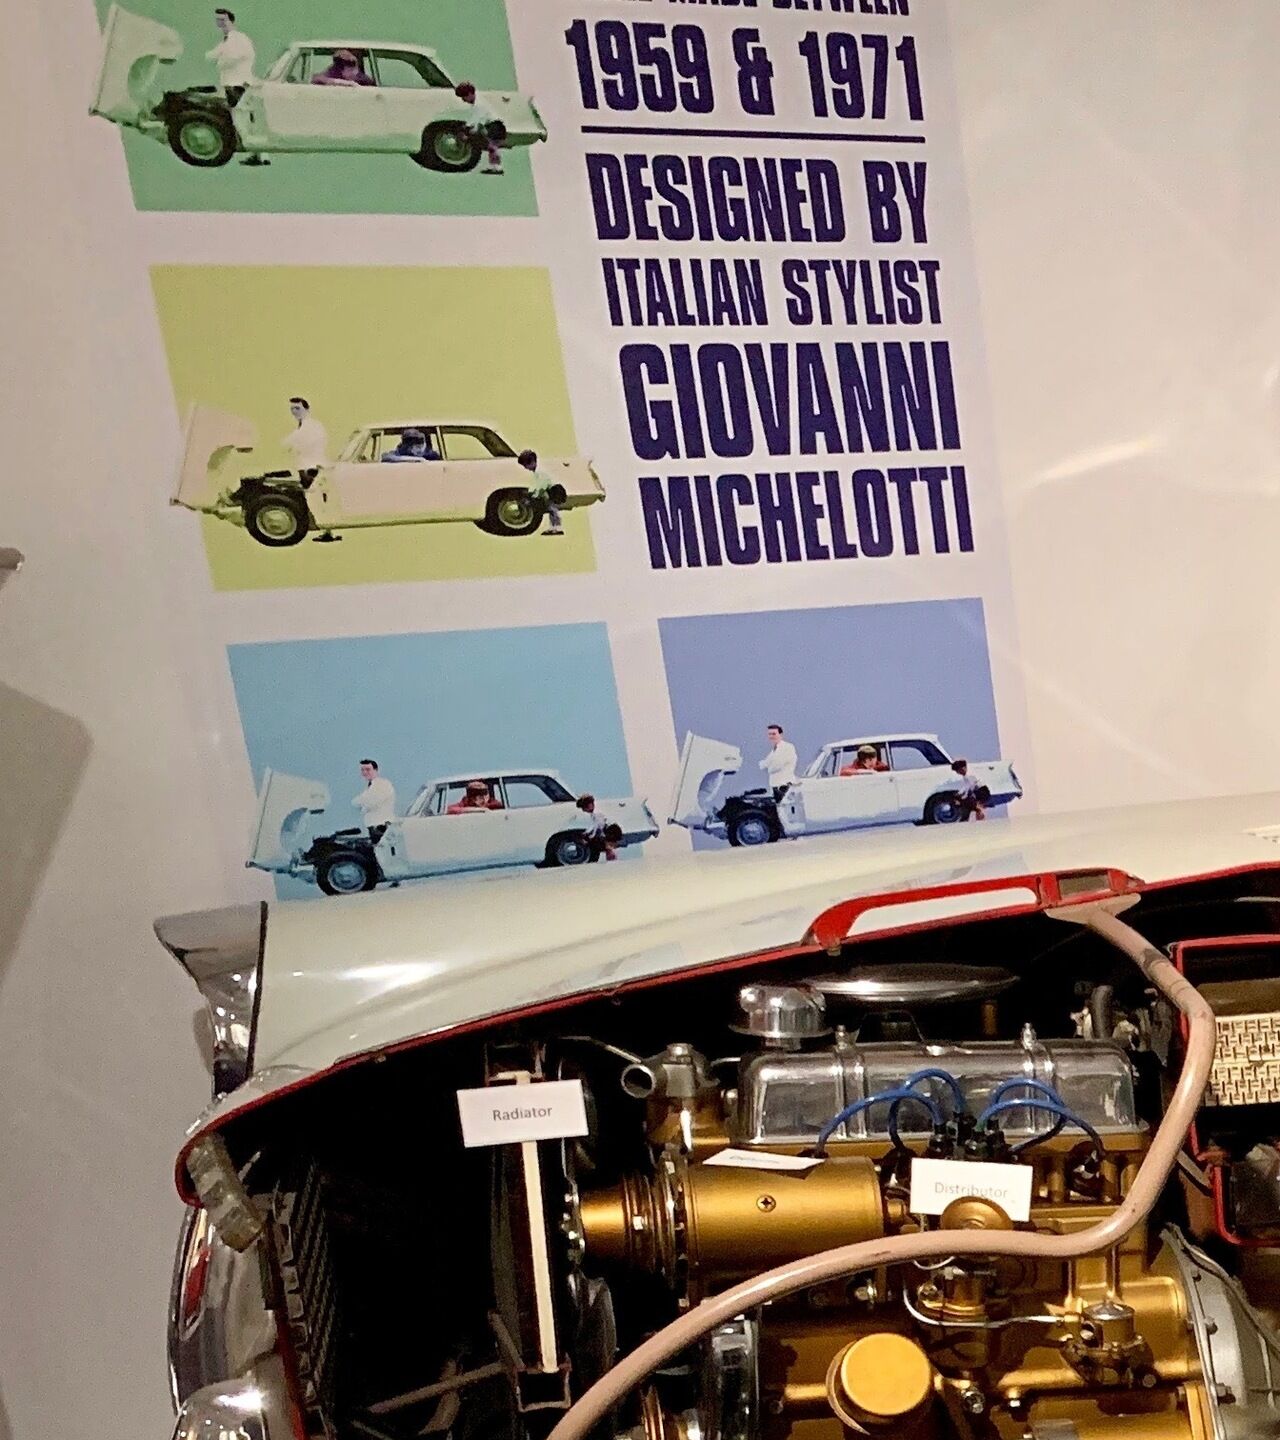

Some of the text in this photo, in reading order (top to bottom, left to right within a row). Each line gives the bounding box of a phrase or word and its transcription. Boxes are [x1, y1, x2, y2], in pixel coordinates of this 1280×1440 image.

[565, 19, 925, 121] 1959 & 1971
[585, 153, 928, 244] DESIGNED BY
[601, 258, 943, 327] ITALIAN STYLIST
[618, 341, 962, 460] GIOVANNI
[637, 465, 975, 570] MICHELOTTI
[492, 1107, 553, 1122] Radiator
[934, 1181, 1009, 1199] Distributor
